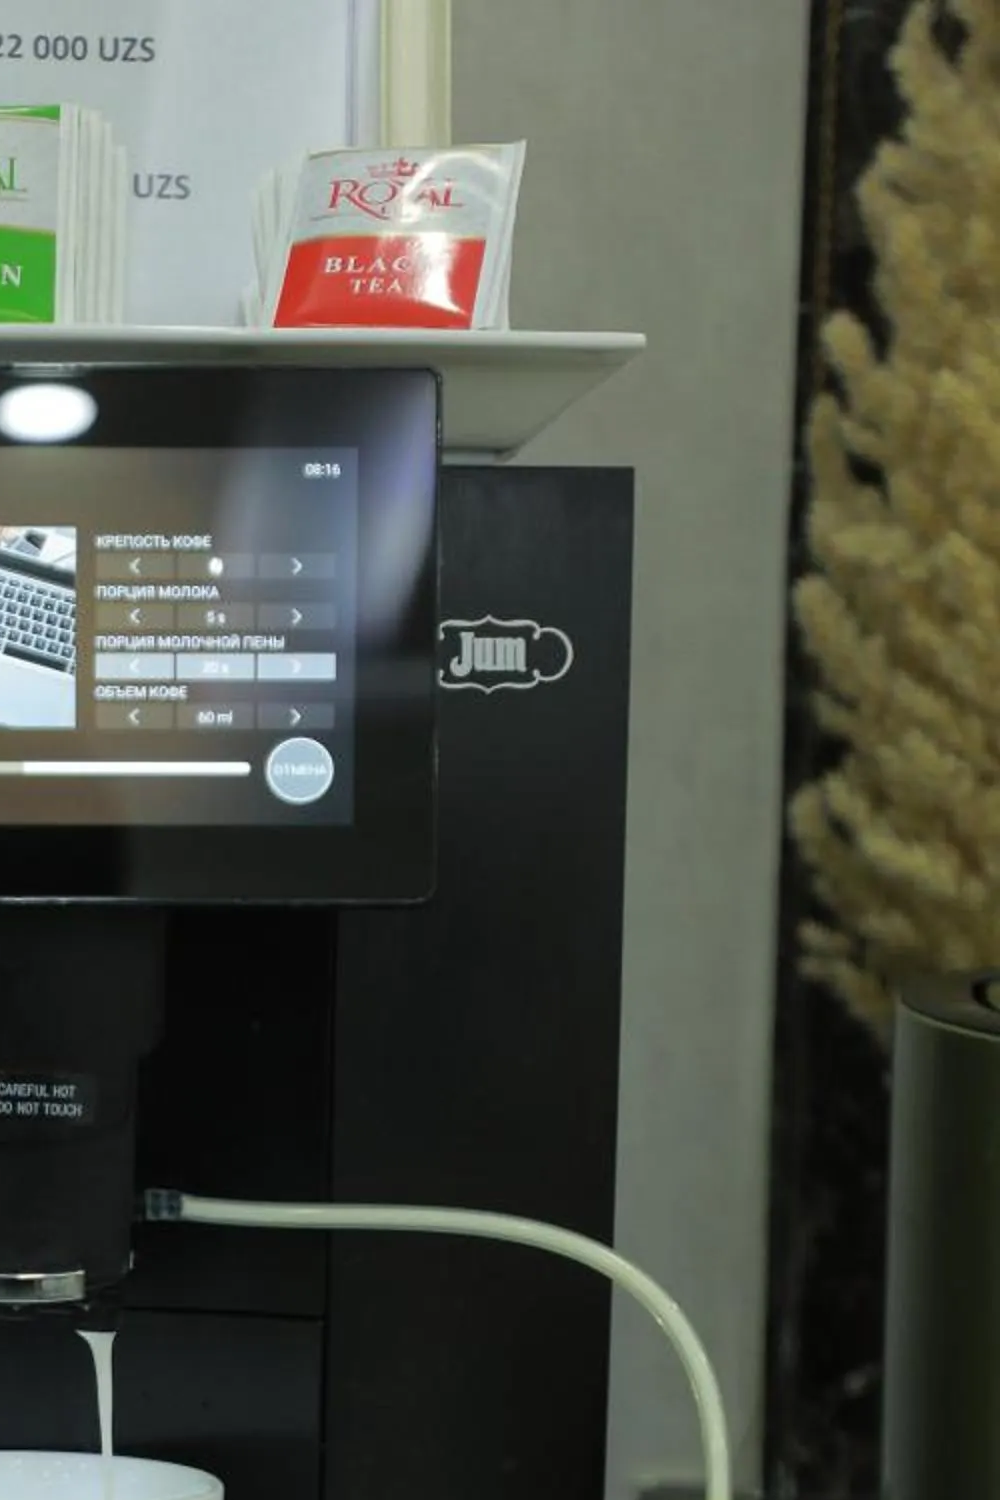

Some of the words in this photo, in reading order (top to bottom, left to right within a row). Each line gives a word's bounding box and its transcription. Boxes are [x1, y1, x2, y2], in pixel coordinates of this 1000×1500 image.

[32, 34, 88, 61] 000
[98, 36, 156, 62] UZS
[133, 173, 190, 200] UZS
[325, 255, 430, 275] BLAC
[351, 277, 403, 293] TEA
[303, 462, 341, 478] 08:16
[95, 534, 170, 549] КРЕПОСТЬ
[173, 534, 213, 548] КОФЕ
[95, 585, 155, 600] ПОРЦИЯ
[159, 585, 220, 599] МОЛОКА
[95, 635, 155, 650] ПОРЦИЯ
[158, 633, 241, 650] МОЛОЧНОЙ
[243, 636, 285, 649] ПЕНЫ
[95, 685, 147, 700] ОБЪЕМ
[149, 685, 188, 699] КОФЕ
[53, 1085, 76, 1098] HOT
[17, 1102, 39, 1115] NOT
[43, 1103, 82, 1117] TOUCH
